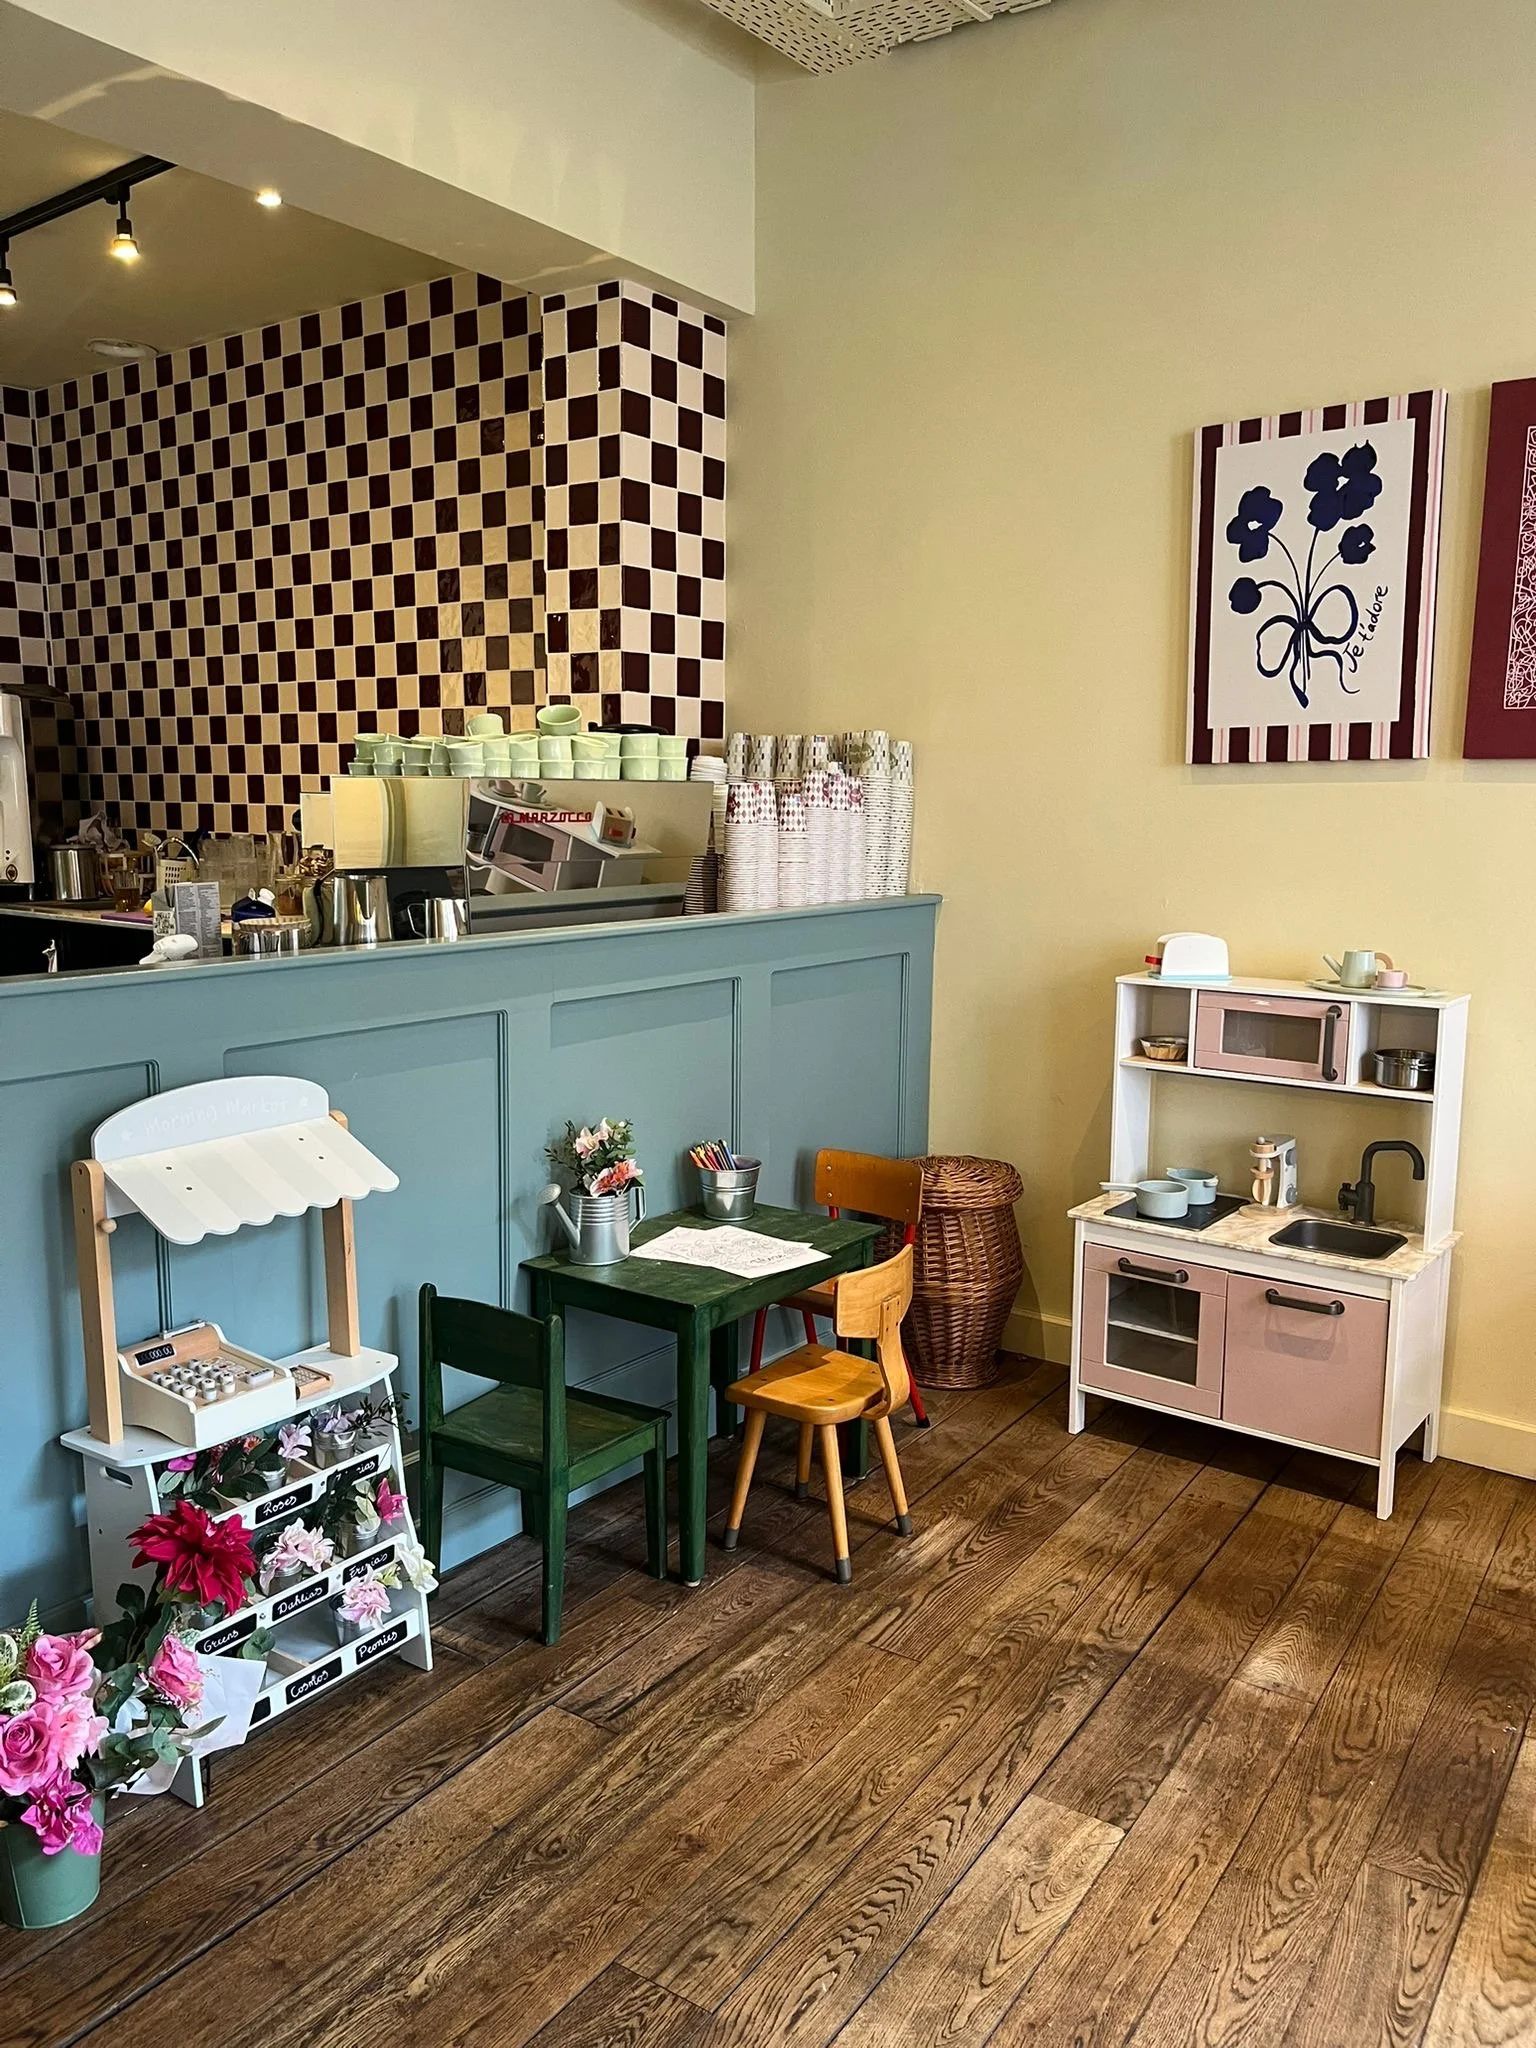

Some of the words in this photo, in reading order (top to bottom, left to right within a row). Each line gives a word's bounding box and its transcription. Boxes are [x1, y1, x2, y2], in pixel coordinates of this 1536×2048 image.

[1342, 642, 1364, 673] Je
[1358, 585, 1388, 642] t'adore
[520, 811, 592, 823] MARZOCCO
[144, 1105, 218, 1135] Morning
[226, 1097, 289, 1118] Market
[263, 1495, 297, 1516] Roses
[277, 1586, 323, 1614] Dahlias
[203, 1628, 239, 1653] Greens
[358, 1631, 397, 1658] Peonies
